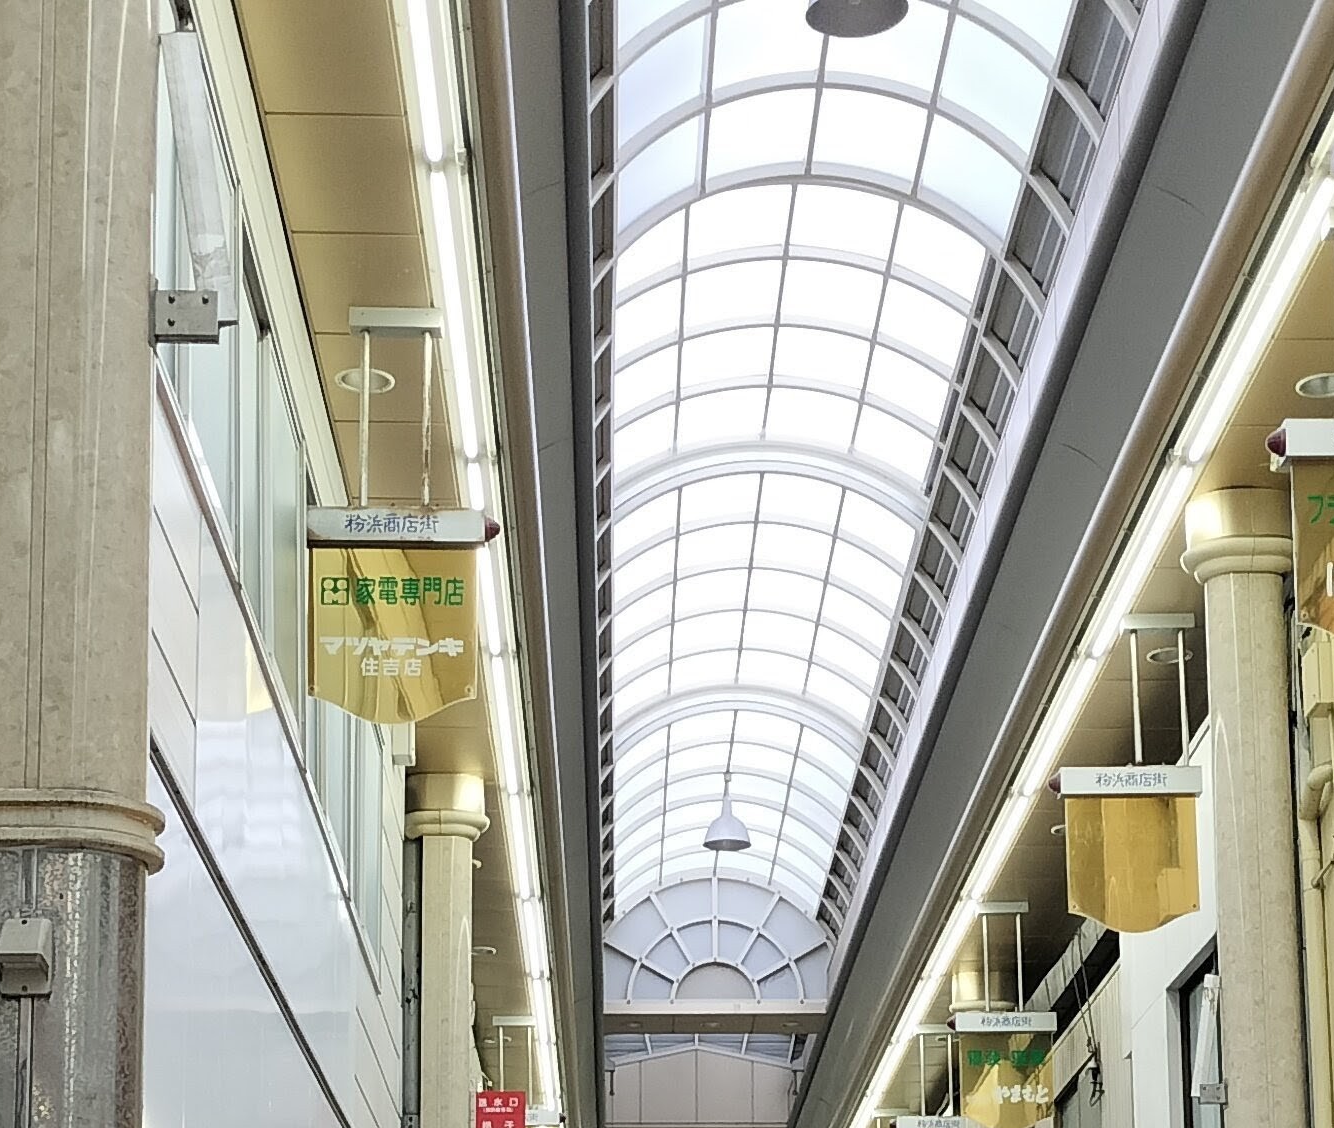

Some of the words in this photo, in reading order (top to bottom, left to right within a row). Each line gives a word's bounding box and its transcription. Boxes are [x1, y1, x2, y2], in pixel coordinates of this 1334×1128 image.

[344, 513, 440, 534] 粉浜商店街
[355, 576, 464, 606] 家電専門店
[319, 636, 464, 657] マツヤデンキ
[360, 658, 422, 677] 住吉店
[1095, 772, 1169, 788] 粉浜商店街
[995, 1084, 1049, 1104] やまもと
